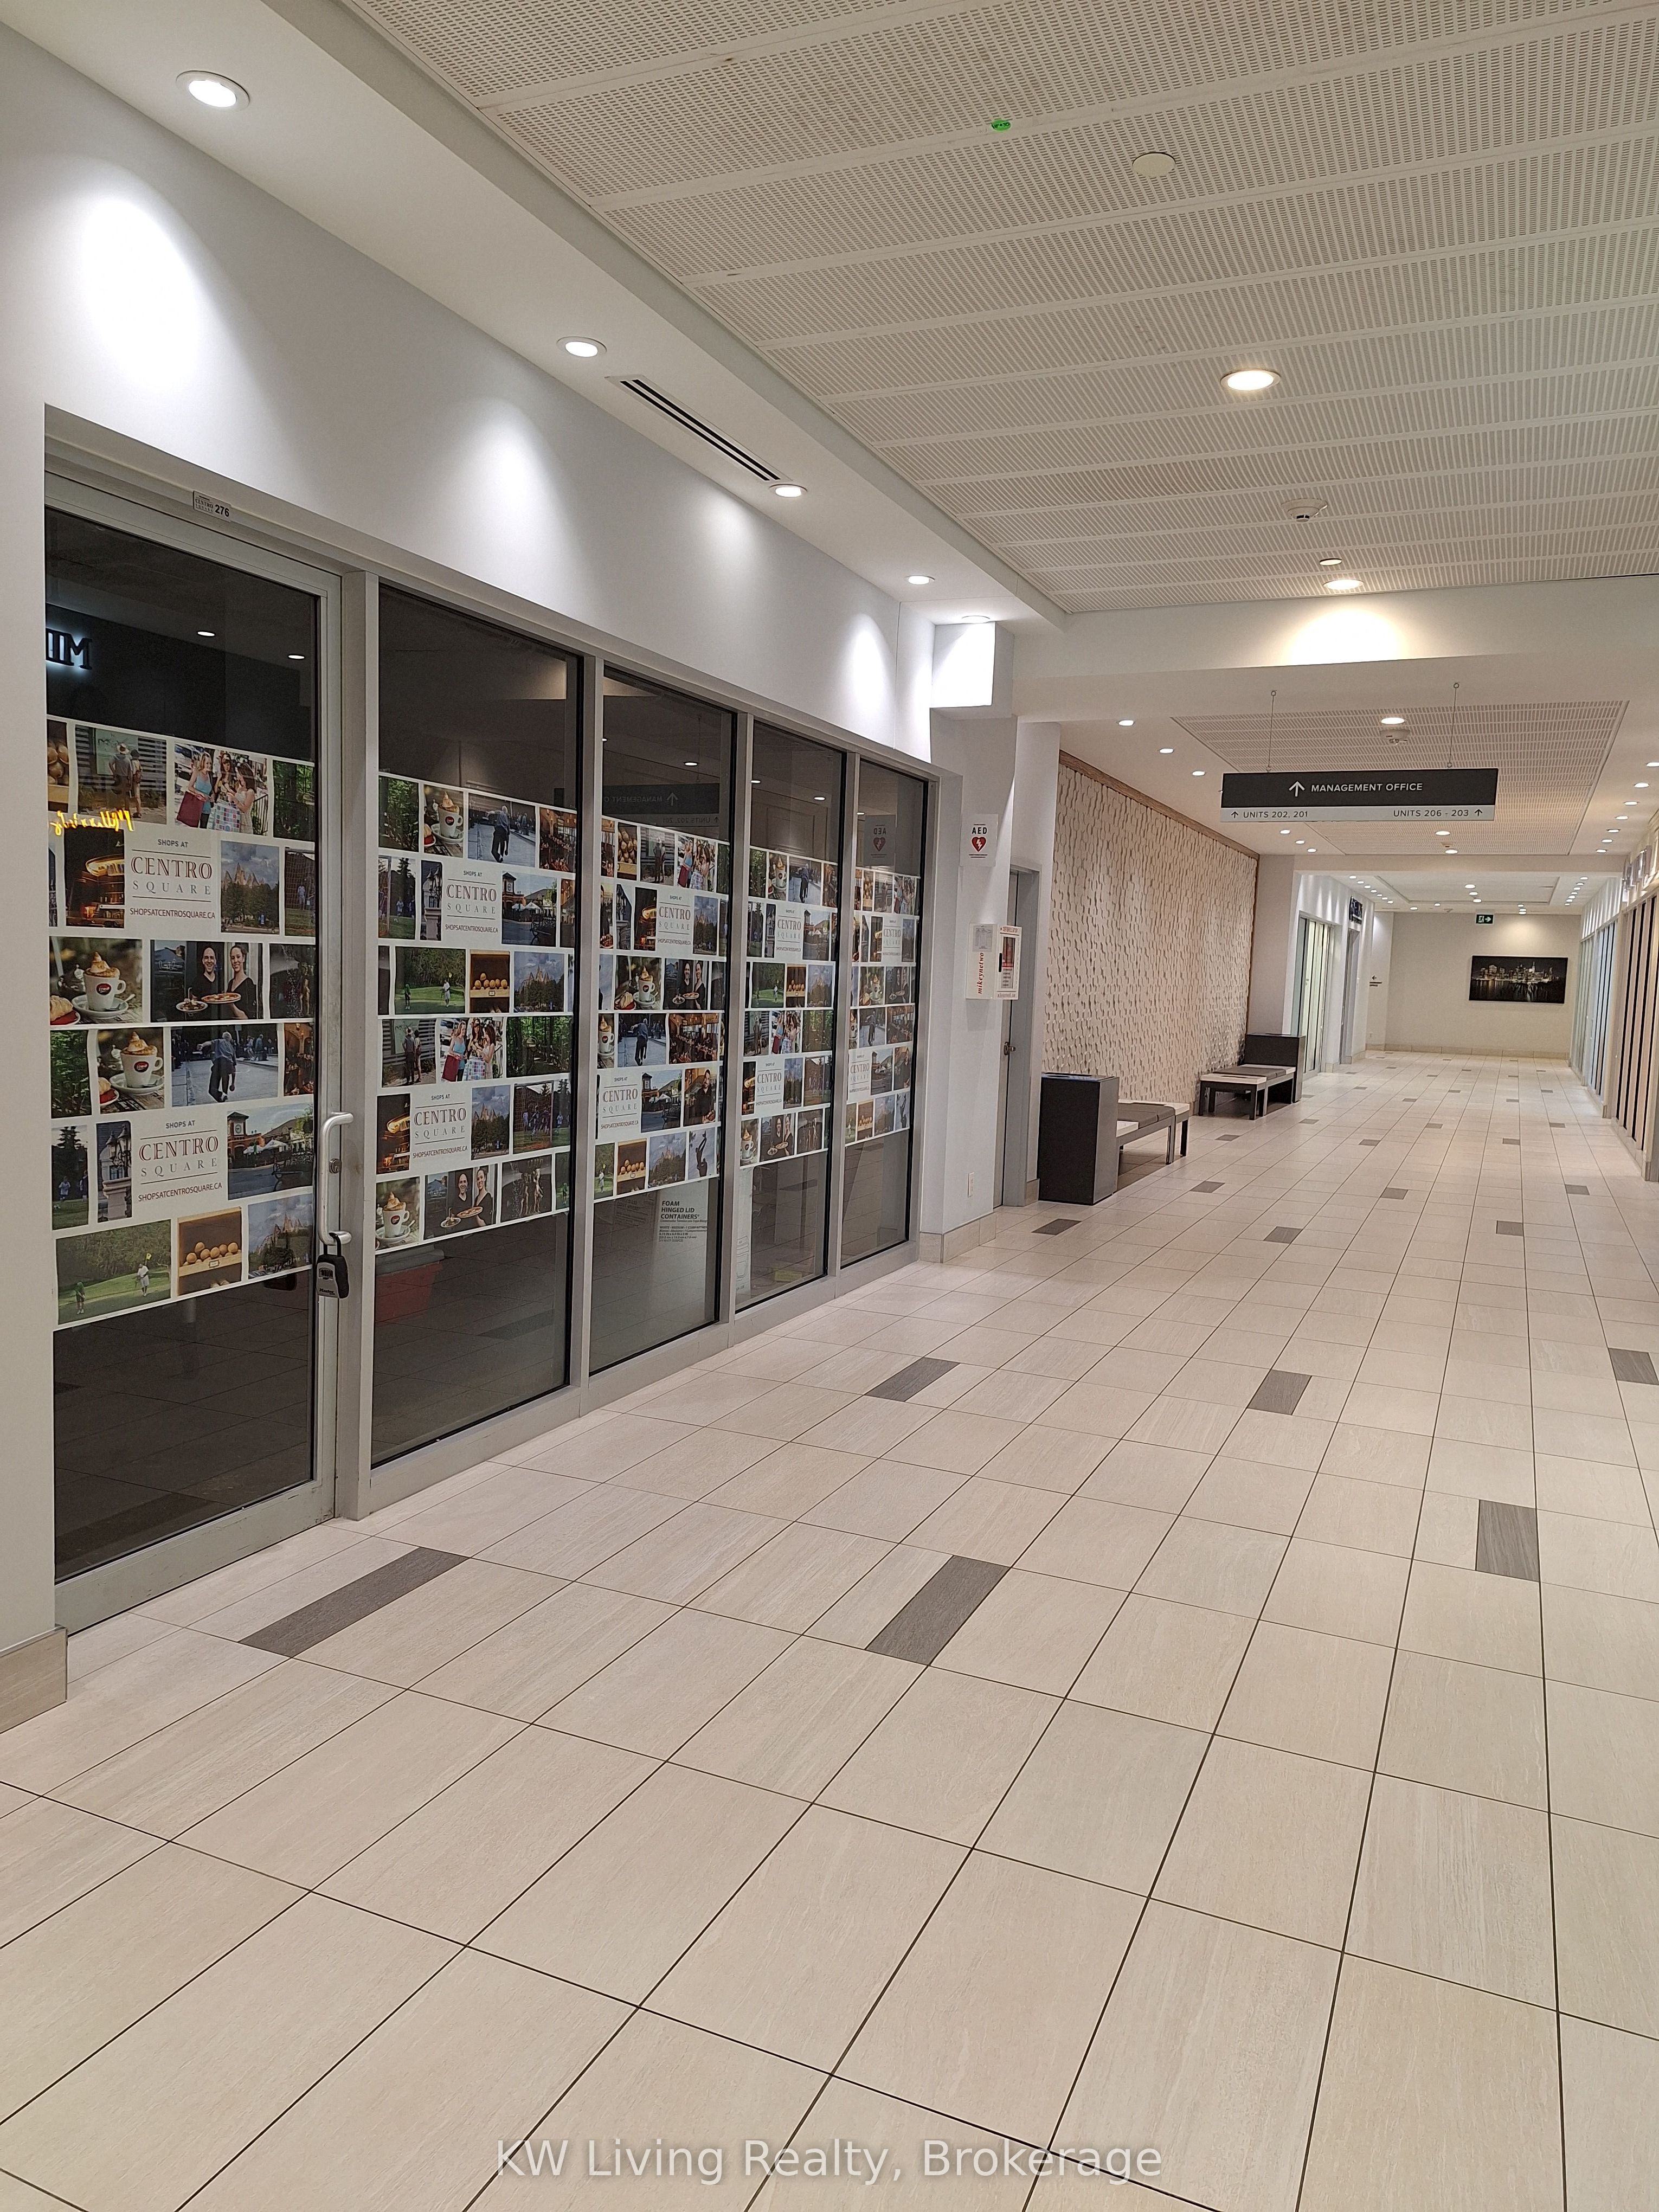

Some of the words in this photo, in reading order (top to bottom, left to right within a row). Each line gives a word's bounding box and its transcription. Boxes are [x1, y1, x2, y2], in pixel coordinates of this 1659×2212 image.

[196, 499, 214, 509] CENTRO
[215, 504, 229, 517] 276
[1311, 783, 1383, 792] MANAGEMENT
[1386, 783, 1423, 791] OFFICE
[131, 857, 212, 879] CENTRO
[133, 880, 210, 895] SQUARE
[446, 884, 497, 902] CENTRO
[130, 908, 215, 918] SHOPSATCENTROSQUARE.CA
[447, 903, 496, 914] SQUARE
[659, 906, 691, 920] CENTRO
[777, 919, 801, 930] CENTRO
[883, 929, 901, 937] CENTRO
[850, 1063, 870, 1073] CENTRO
[757, 1072, 782, 1083] CENTRO
[602, 1088, 638, 1102] CENTRO
[602, 1103, 637, 1114] SQUARE
[414, 1108, 466, 1126] CENTRO
[165, 1121, 186, 1129] SHOPS
[415, 1126, 465, 1139] SQUARE
[139, 1136, 218, 1161] CENTRO
[141, 1158, 217, 1176] SQUARE
[138, 1182, 222, 1201] SHOPSATCENTROSQUARE.CA
